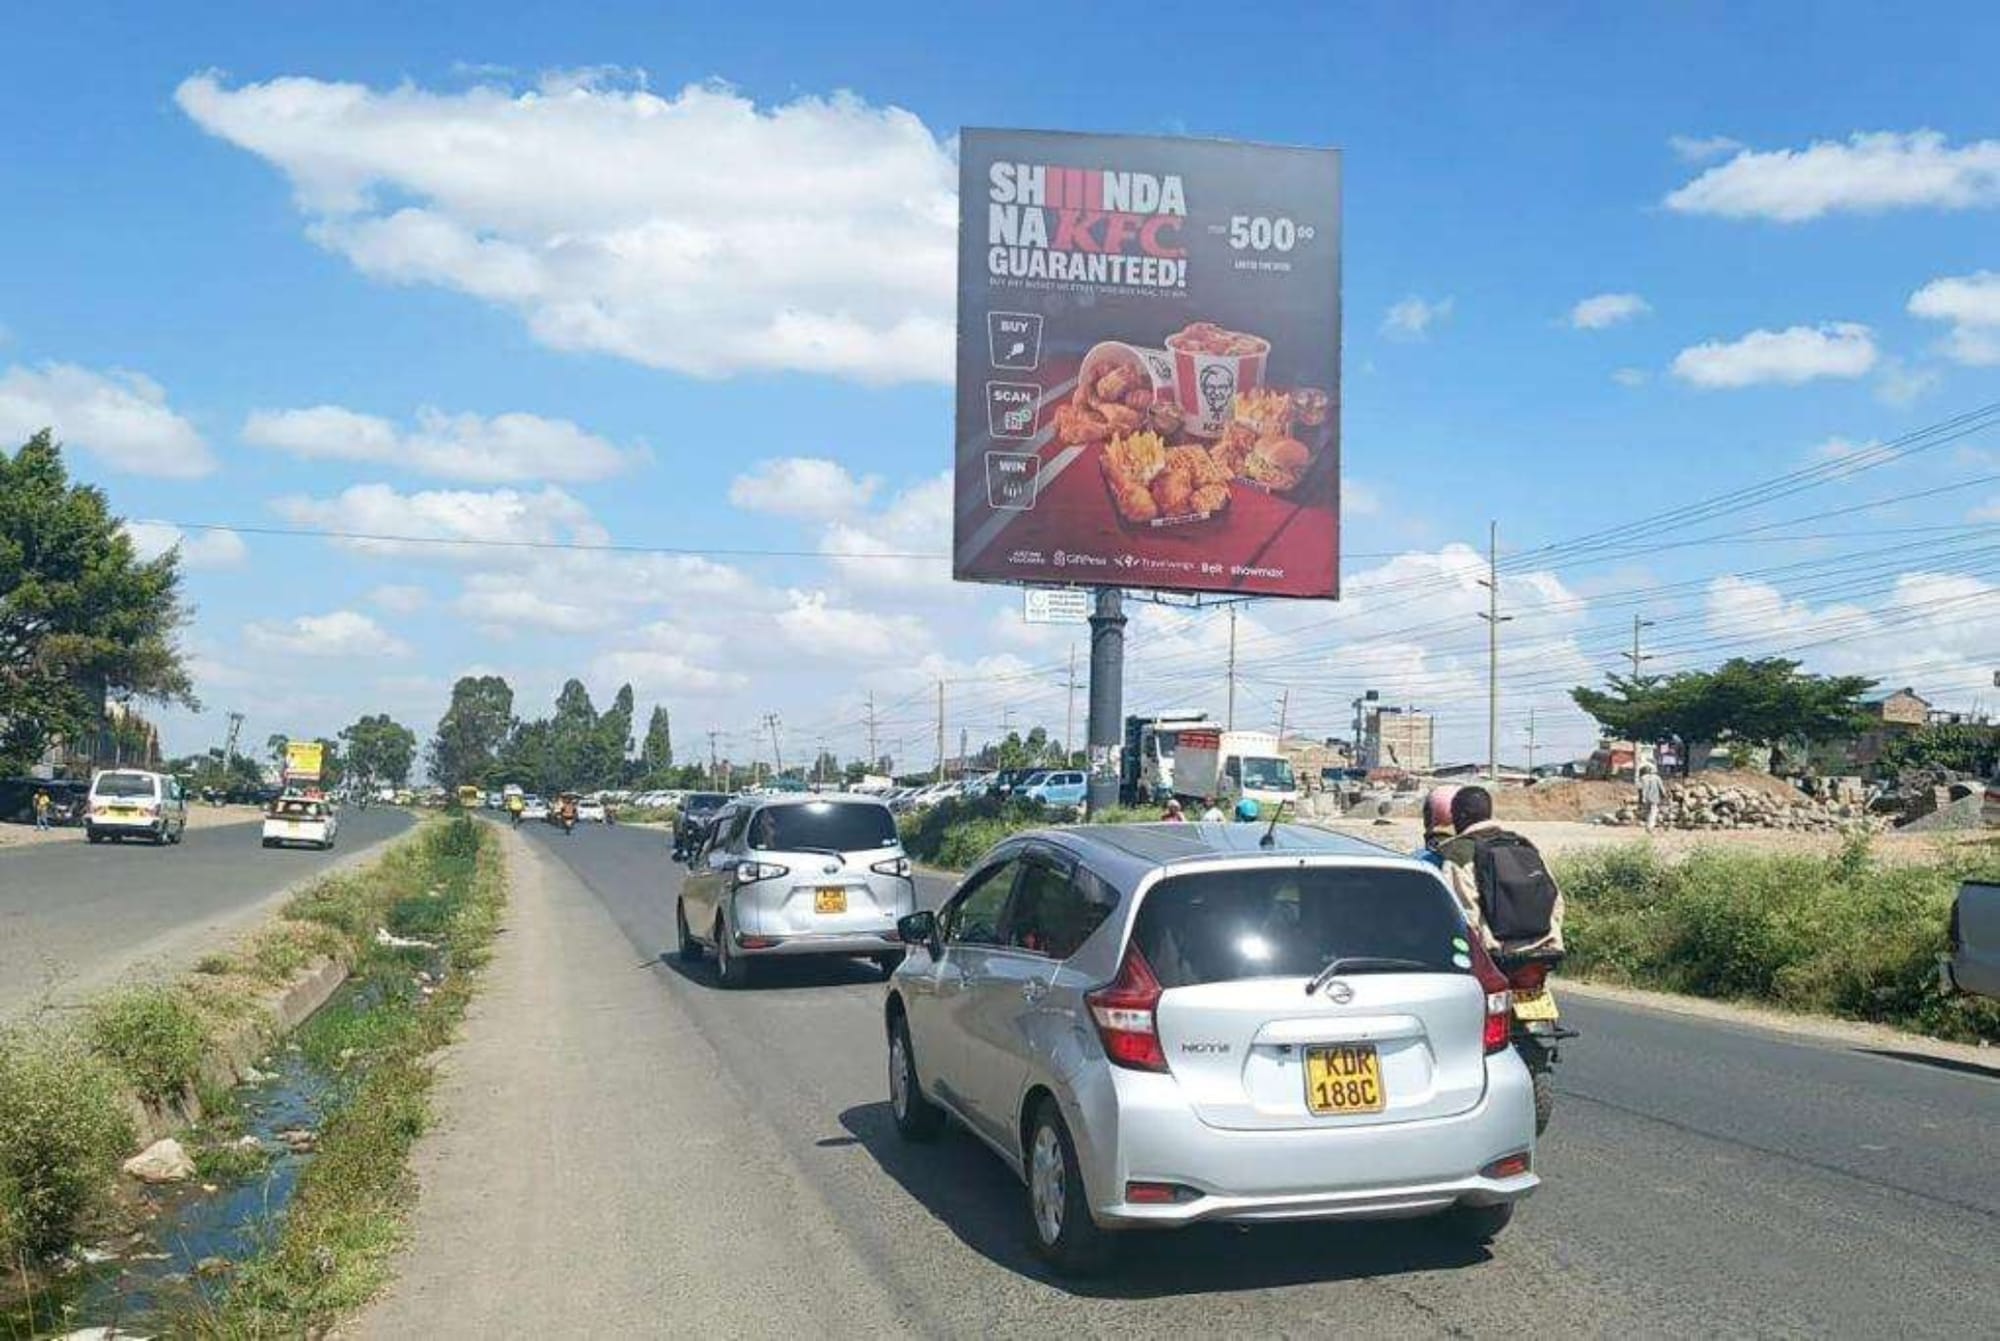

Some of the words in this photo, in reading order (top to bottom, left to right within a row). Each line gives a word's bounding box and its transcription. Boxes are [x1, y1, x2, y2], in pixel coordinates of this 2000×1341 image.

[989, 203, 1048, 248] NA
[1051, 209, 1189, 258] KFC
[1230, 216, 1296, 252] 500
[988, 247, 1187, 288] GUARANTEED!
[1001, 320, 1028, 333] BUY
[993, 390, 1031, 402] SCAN
[1000, 461, 1026, 473] WIN
[1325, 1047, 1372, 1076] KDR
[1316, 1079, 1377, 1108] 188C
